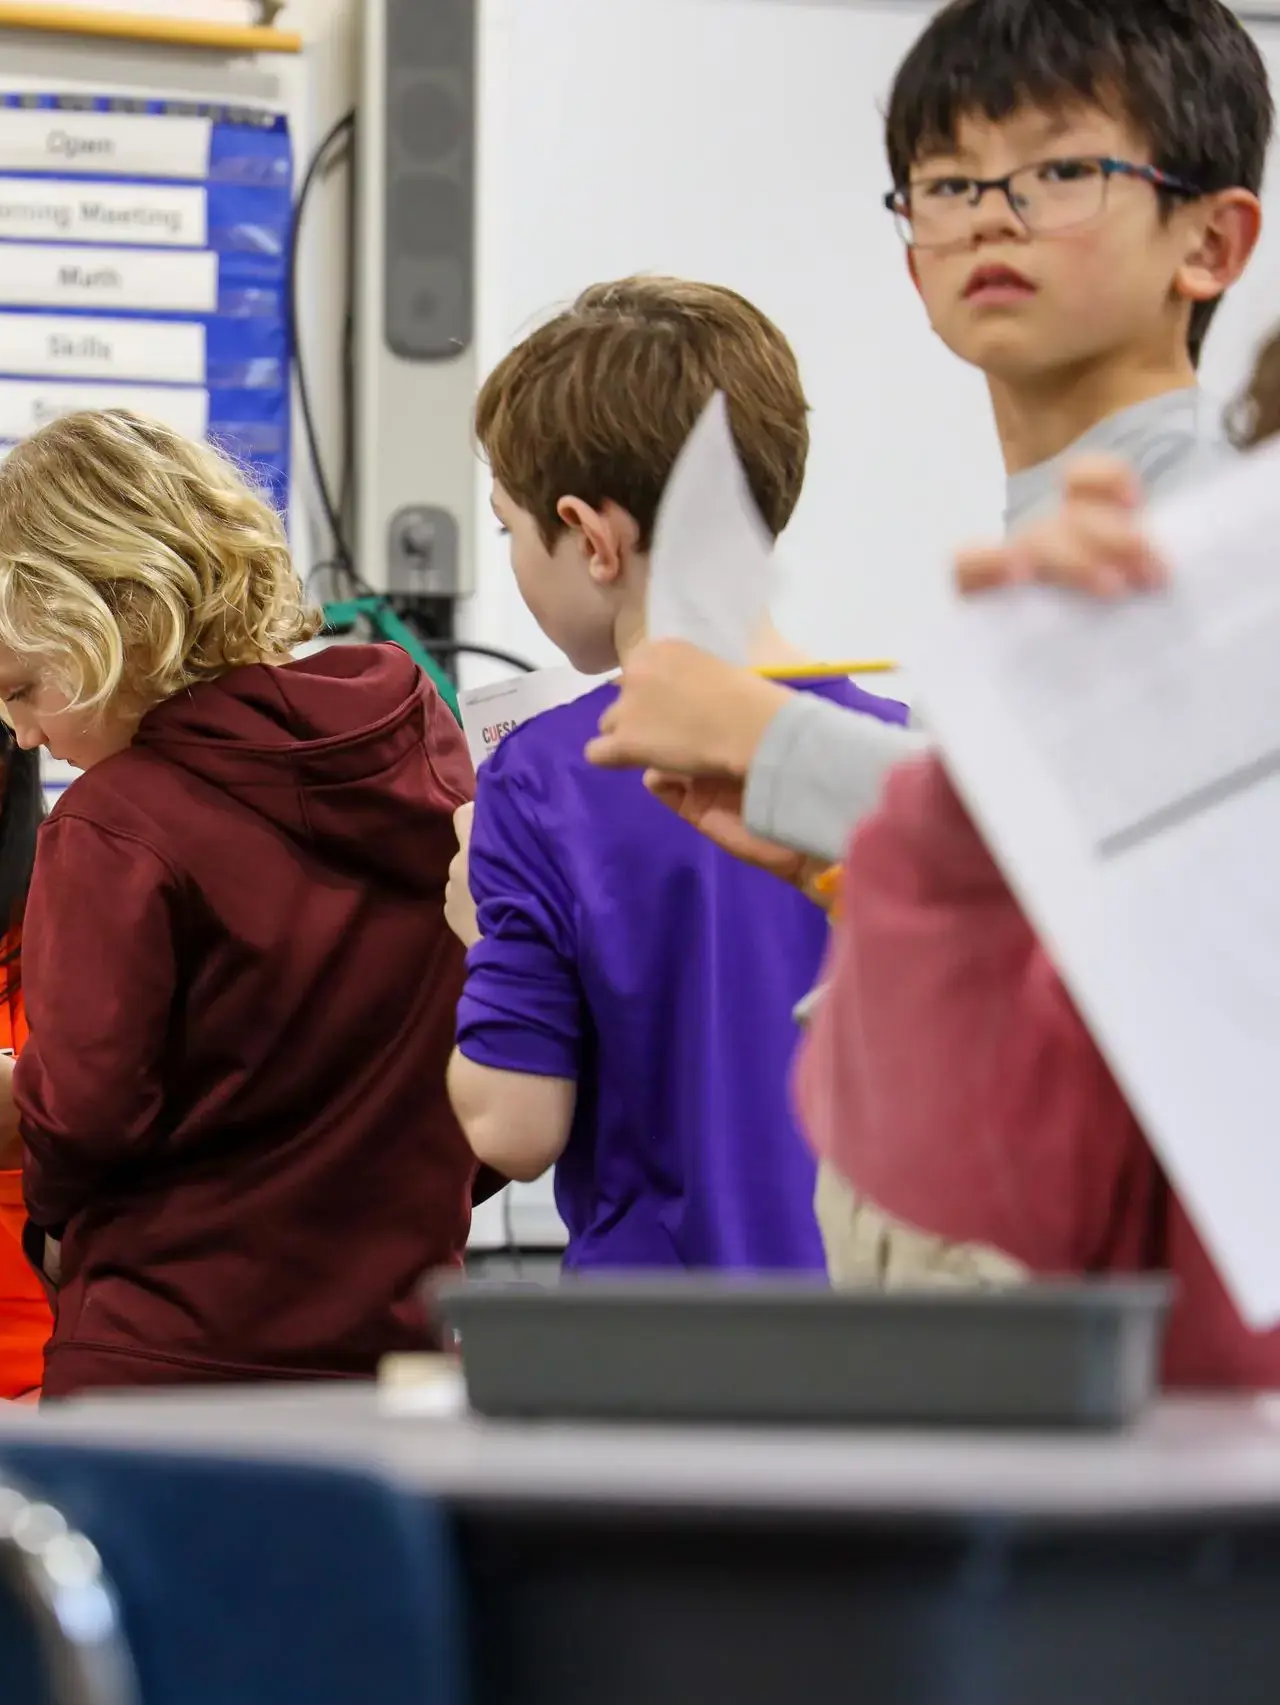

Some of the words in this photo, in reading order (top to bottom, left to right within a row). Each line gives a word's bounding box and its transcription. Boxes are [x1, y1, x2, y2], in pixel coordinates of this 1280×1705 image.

[46, 130, 114, 159] Open
[79, 200, 183, 231] Meeting
[57, 265, 121, 288] Math
[47, 332, 112, 359] Skills
